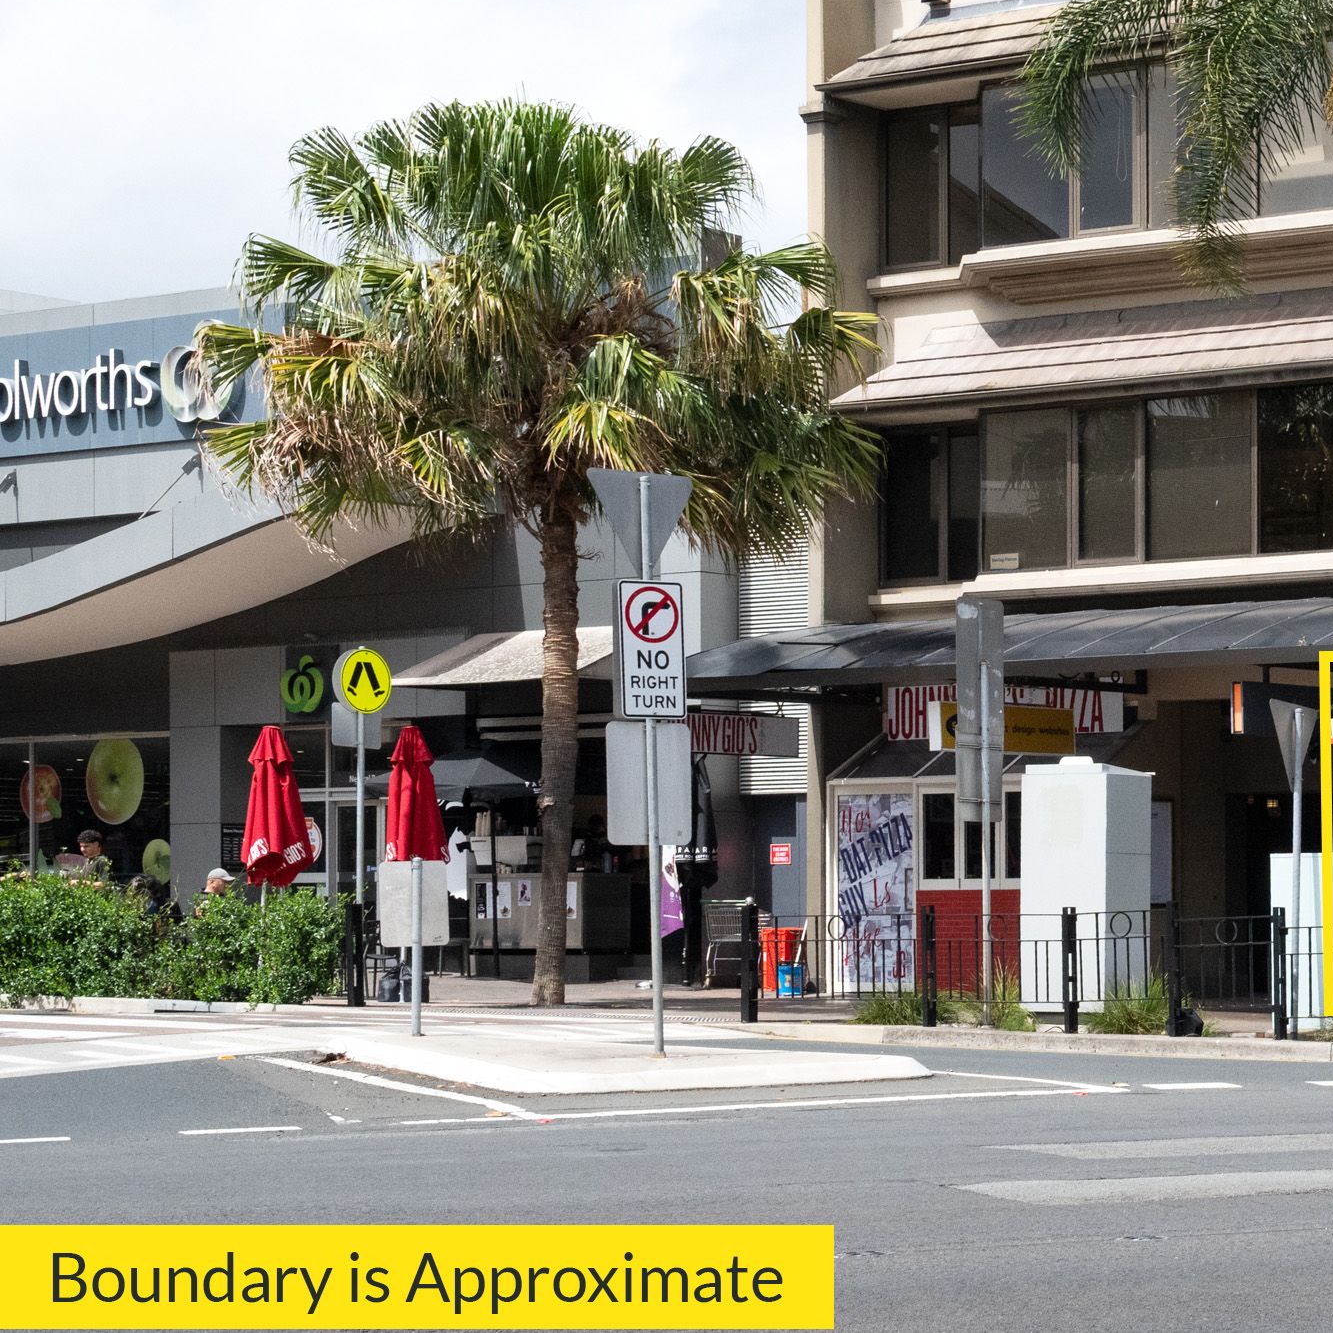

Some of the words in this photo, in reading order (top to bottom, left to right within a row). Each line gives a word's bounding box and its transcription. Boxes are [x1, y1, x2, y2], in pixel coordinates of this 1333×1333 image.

[637, 650, 669, 670] NO
[630, 675, 679, 689] RIGHT
[632, 694, 677, 708] TURN
[722, 716, 758, 754] GIO'S
[869, 813, 913, 866] PIZZA
